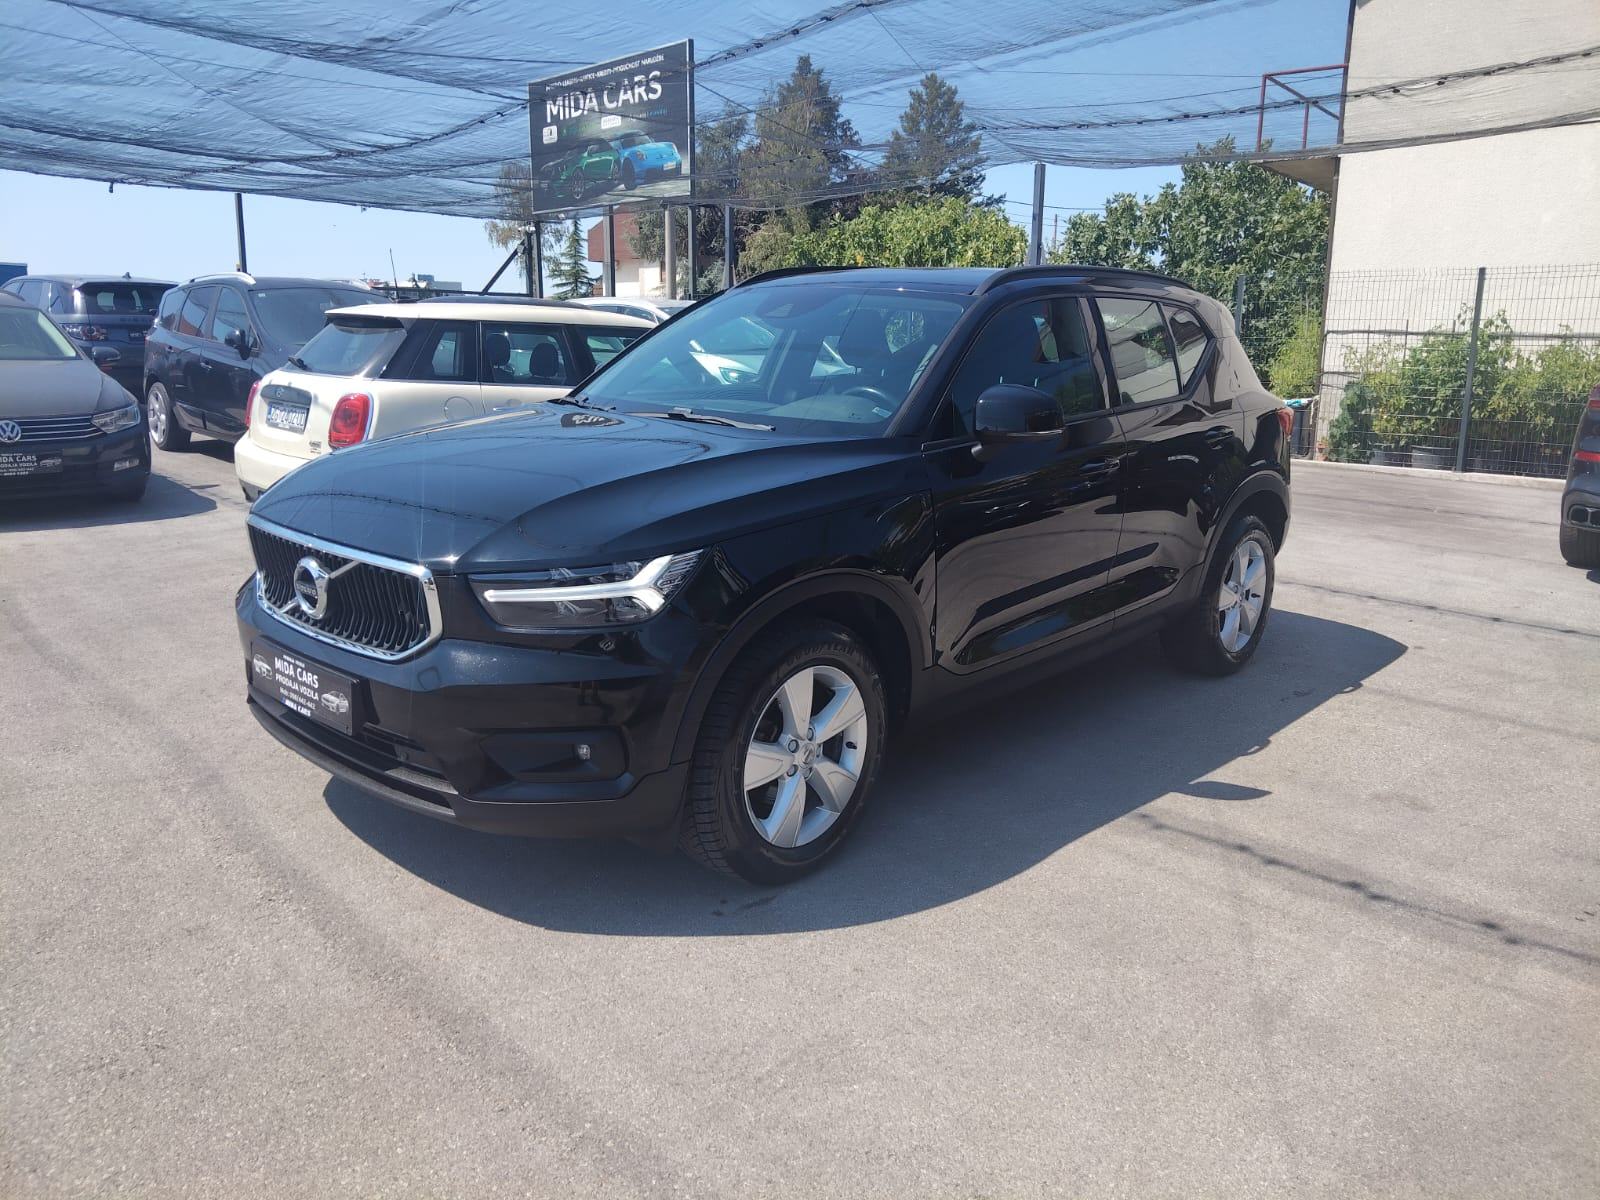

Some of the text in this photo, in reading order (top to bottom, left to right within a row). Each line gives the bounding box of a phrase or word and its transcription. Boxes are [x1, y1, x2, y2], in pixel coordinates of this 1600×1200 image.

[546, 88, 600, 123] MIDA
[603, 71, 662, 109] CARS
[275, 656, 295, 678] MIDA
[297, 668, 319, 689] CARS
[276, 673, 319, 701] PRODAJA VOZILA
